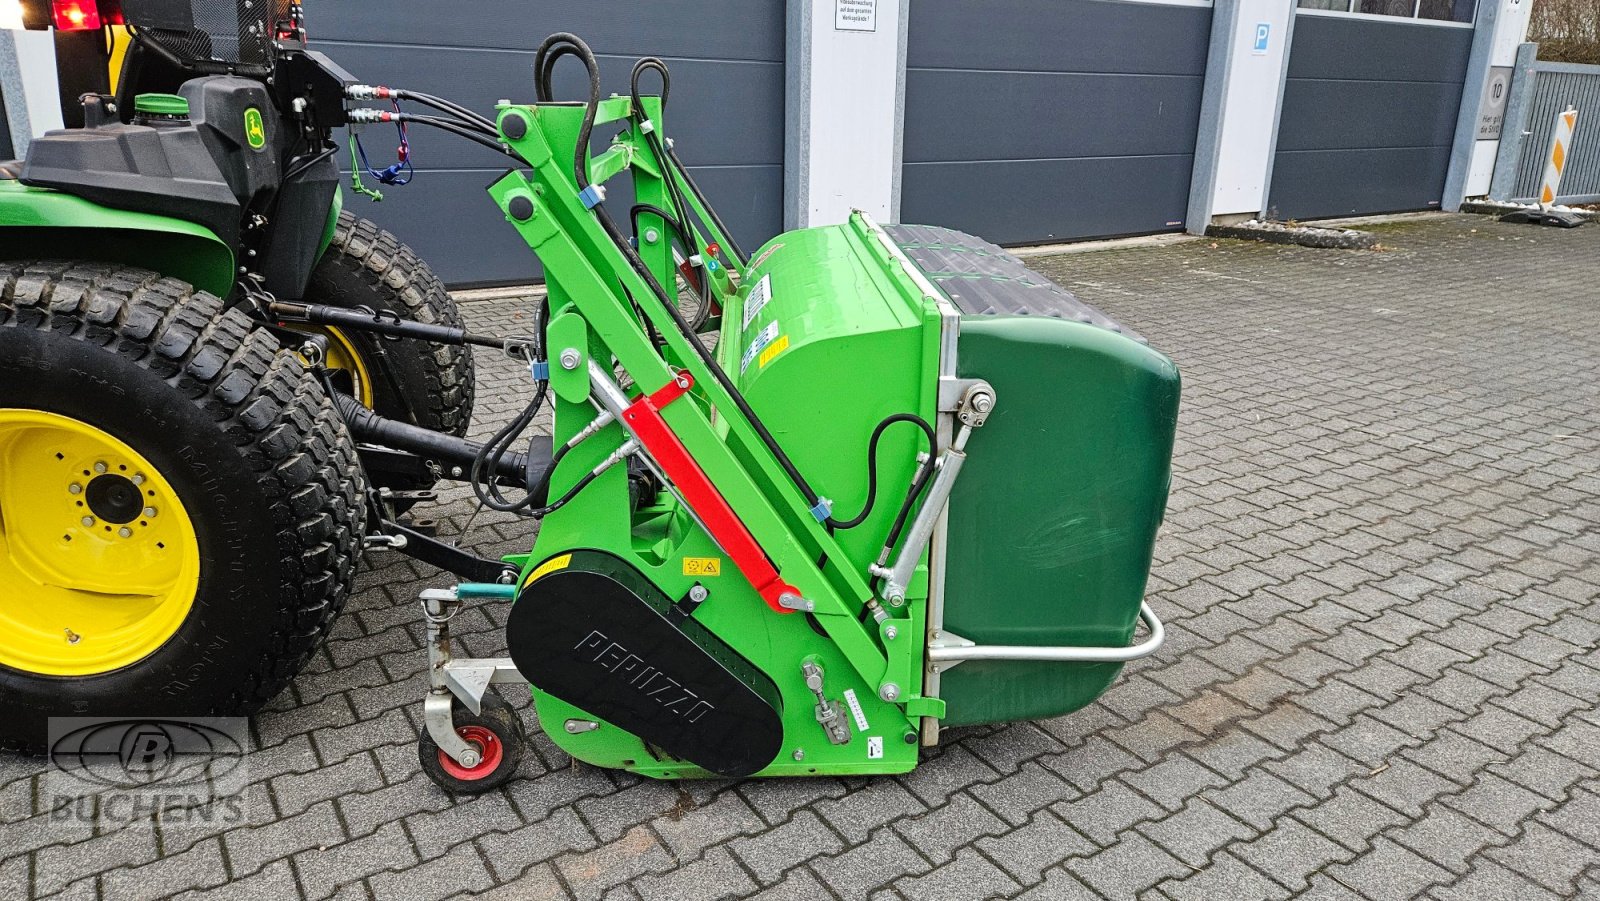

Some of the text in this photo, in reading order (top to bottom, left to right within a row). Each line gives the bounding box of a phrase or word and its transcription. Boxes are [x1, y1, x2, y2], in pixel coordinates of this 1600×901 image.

[1256, 25, 1268, 48] P
[1493, 83, 1502, 98] 10
[574, 630, 715, 723] PERUZZO
